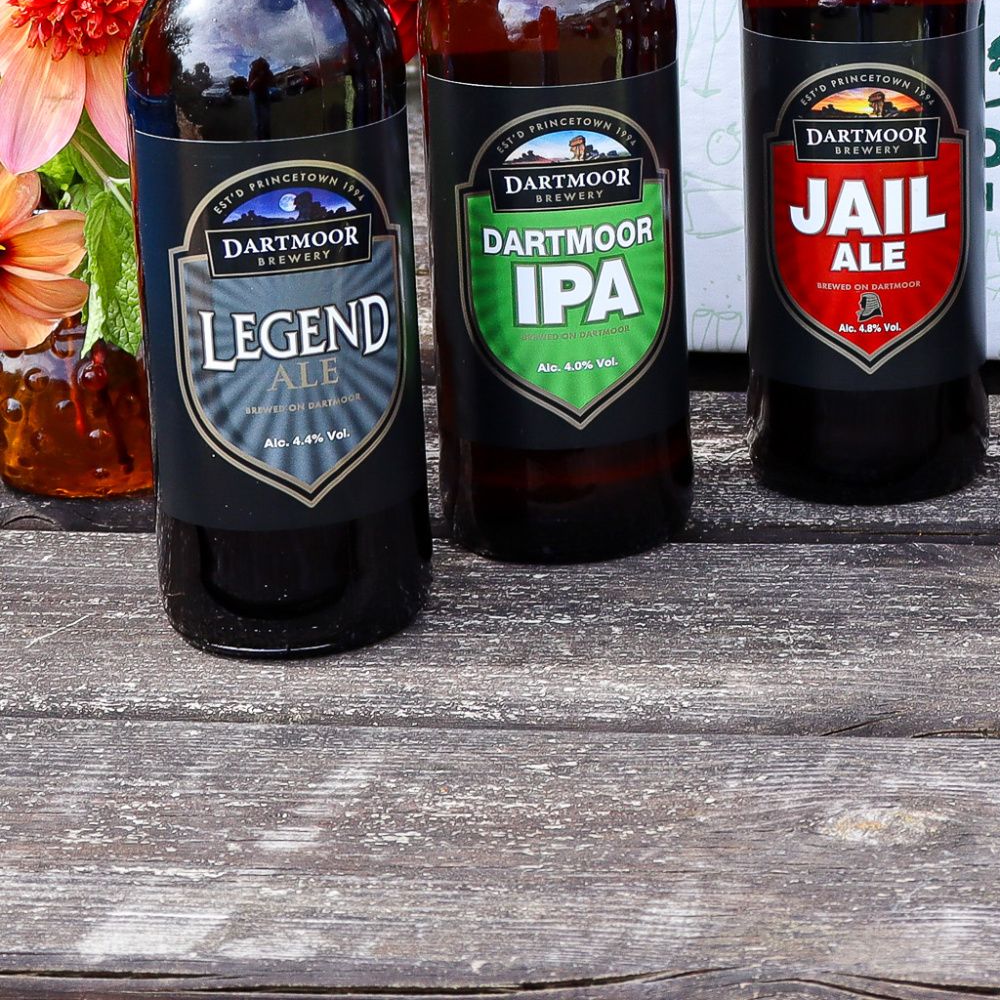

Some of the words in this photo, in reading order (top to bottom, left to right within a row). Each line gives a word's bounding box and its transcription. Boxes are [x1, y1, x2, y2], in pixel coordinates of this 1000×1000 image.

[800, 85, 827, 106] EST'D
[831, 74, 911, 89] PRINCETOWN
[914, 86, 935, 105] 1994
[496, 130, 525, 153] EST'D
[529, 117, 612, 133] PRINCETOWN
[616, 127, 637, 146] 1994
[806, 127, 927, 146] DARTMOOR
[835, 145, 900, 155] BREWERY
[213, 189, 245, 215] EST'D
[249, 172, 339, 192] PRINCETOWN
[342, 181, 366, 202] 1994
[504, 168, 631, 194] DARTMOOR
[536, 190, 603, 203] BREWERY
[790, 175, 947, 237] JAIL
[222, 226, 359, 259] DARTMOOR
[482, 216, 654, 256] DARTMOOR
[258, 250, 330, 266] BREWERY
[830, 240, 907, 273] ALE
[513, 257, 644, 327] IPA
[817, 282, 852, 291] BREWED
[871, 280, 921, 290] DARTMOOR
[199, 293, 390, 372] LEGEND
[580, 325, 630, 339] DARTMOOR
[839, 323, 857, 333] Alc.
[859, 323, 882, 333] 4.8%
[883, 322, 901, 332] Vol.
[267, 357, 340, 392] ALE
[537, 363, 561, 373] Alc.
[564, 360, 594, 371] 4.0%
[596, 357, 618, 368] Vol.
[245, 404, 286, 415] BREWED
[288, 403, 305, 412] ON
[308, 393, 360, 410] DARTMOOR
[264, 438, 290, 448] Alc.
[292, 433, 324, 446] 4.4%
[327, 428, 350, 441] Vol.
